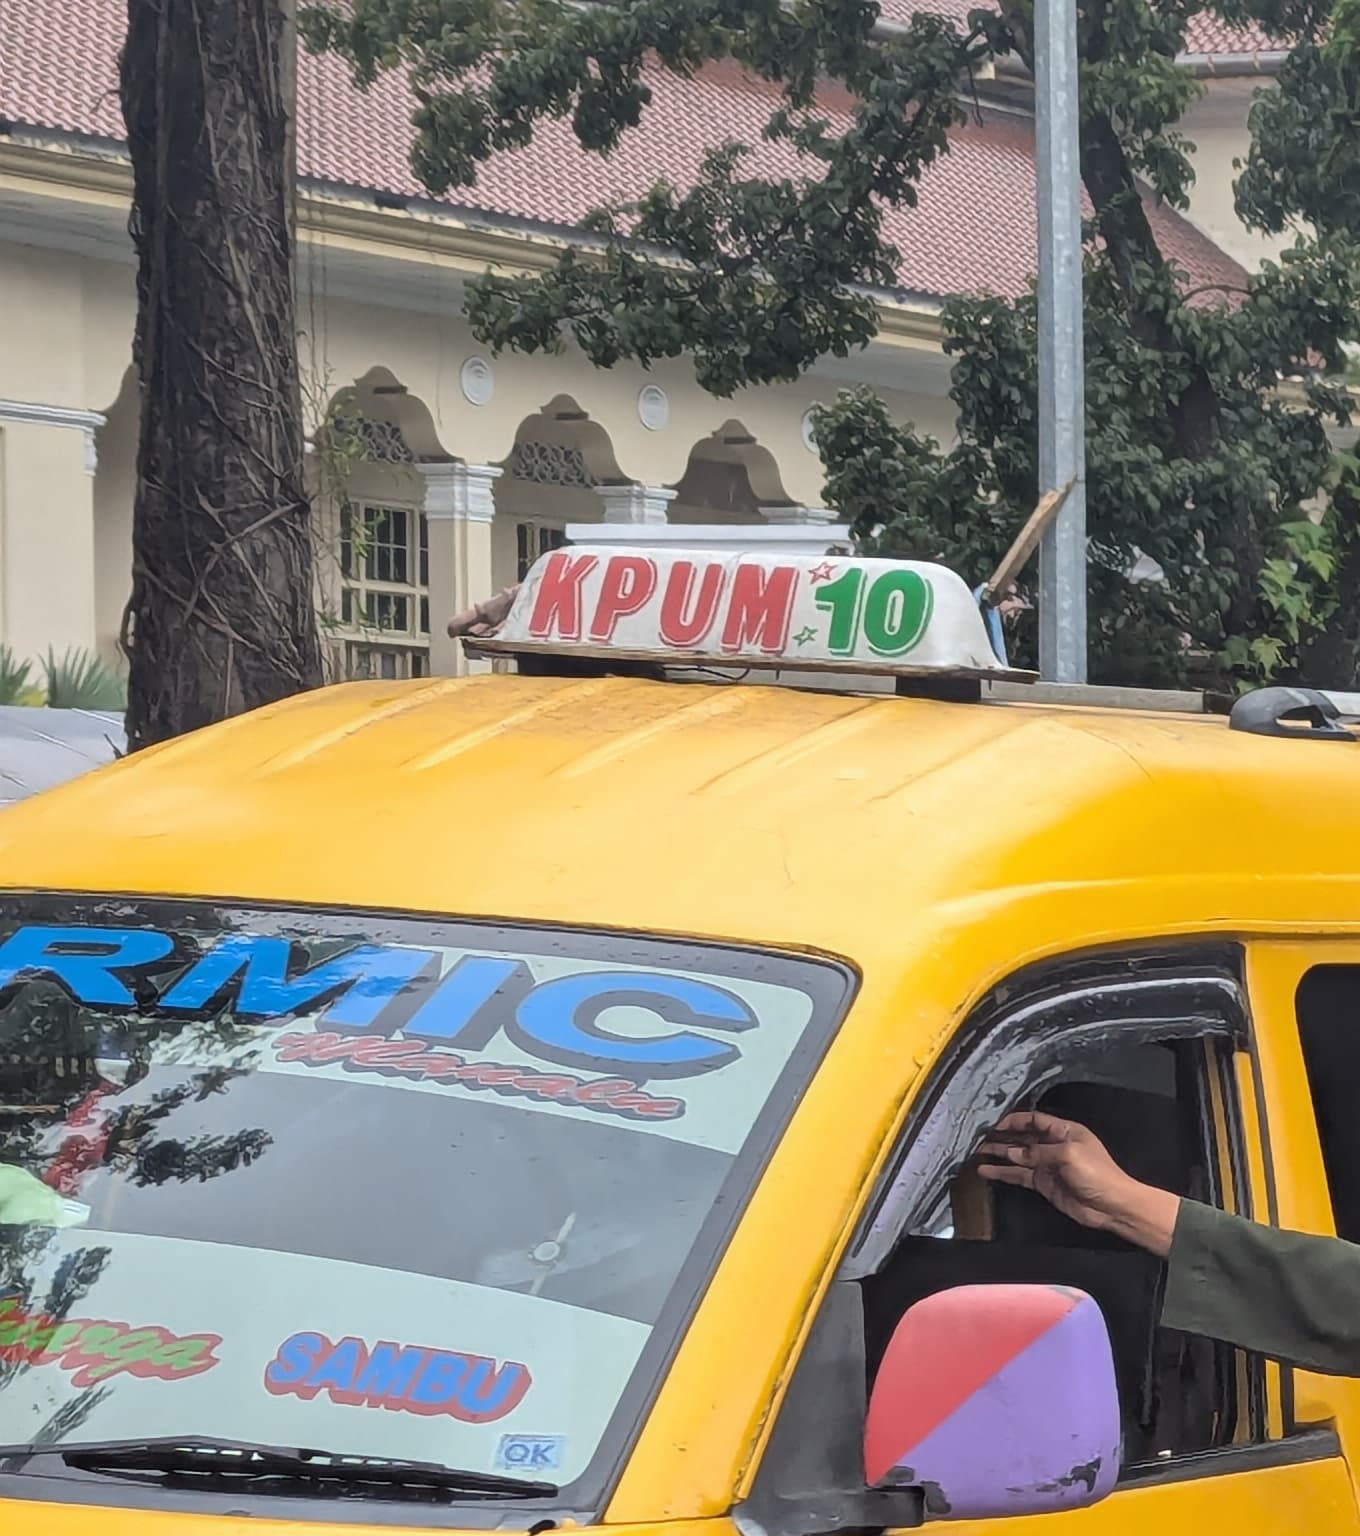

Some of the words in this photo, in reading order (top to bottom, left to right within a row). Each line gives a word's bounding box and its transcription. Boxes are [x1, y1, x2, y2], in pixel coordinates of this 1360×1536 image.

[528, 553, 799, 653] KPUM
[814, 566, 932, 657] 10
[265, 1331, 526, 1417] SAMBU
[504, 1443, 554, 1463] OK
